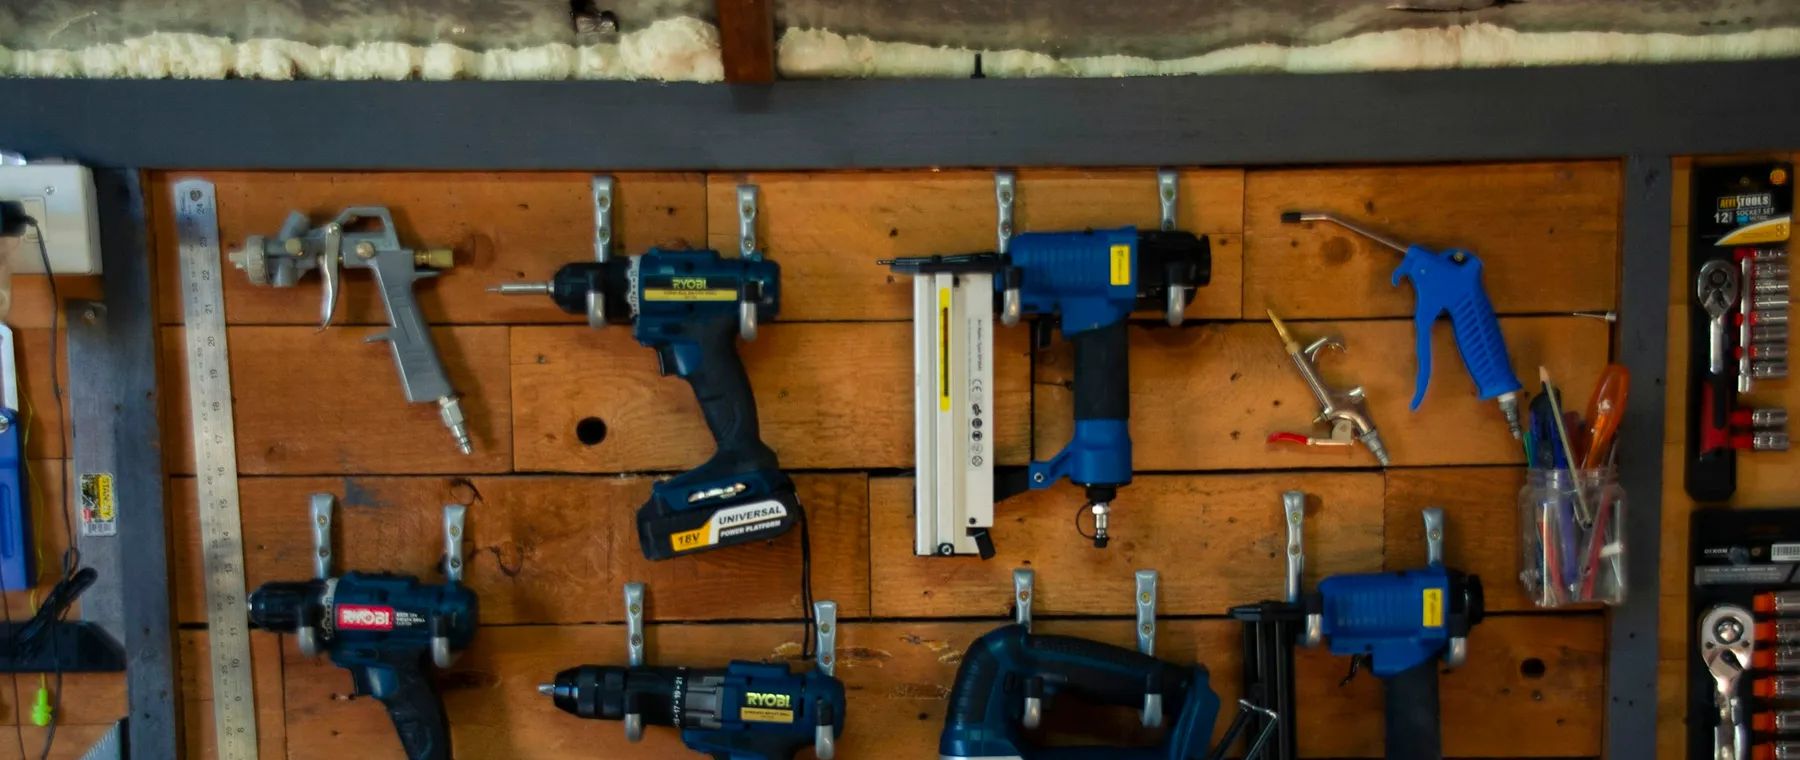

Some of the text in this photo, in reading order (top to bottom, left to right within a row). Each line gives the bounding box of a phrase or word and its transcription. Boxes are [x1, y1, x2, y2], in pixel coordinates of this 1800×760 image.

[197, 203, 205, 215] 24
[1713, 212, 1729, 223] 12
[200, 236, 207, 247] 23
[203, 270, 210, 280] 22
[672, 278, 707, 289] RYOBI
[206, 304, 213, 314] 21
[208, 336, 215, 347] 20
[210, 369, 217, 379] 19
[213, 401, 220, 412] 18
[215, 435, 223, 444] 17
[218, 466, 225, 476] 16
[220, 499, 227, 509] 15
[719, 506, 782, 525] UNIVERSAL
[720, 520, 781, 537] POWER PLATFORM
[223, 531, 230, 541] 14
[677, 533, 700, 544] 18V
[224, 563, 232, 573] 13
[228, 594, 236, 605] 12
[231, 627, 237, 636] 11
[231, 658, 239, 669] 10
[745, 692, 791, 707] RYOBI
[226, 726, 233, 736] 20
